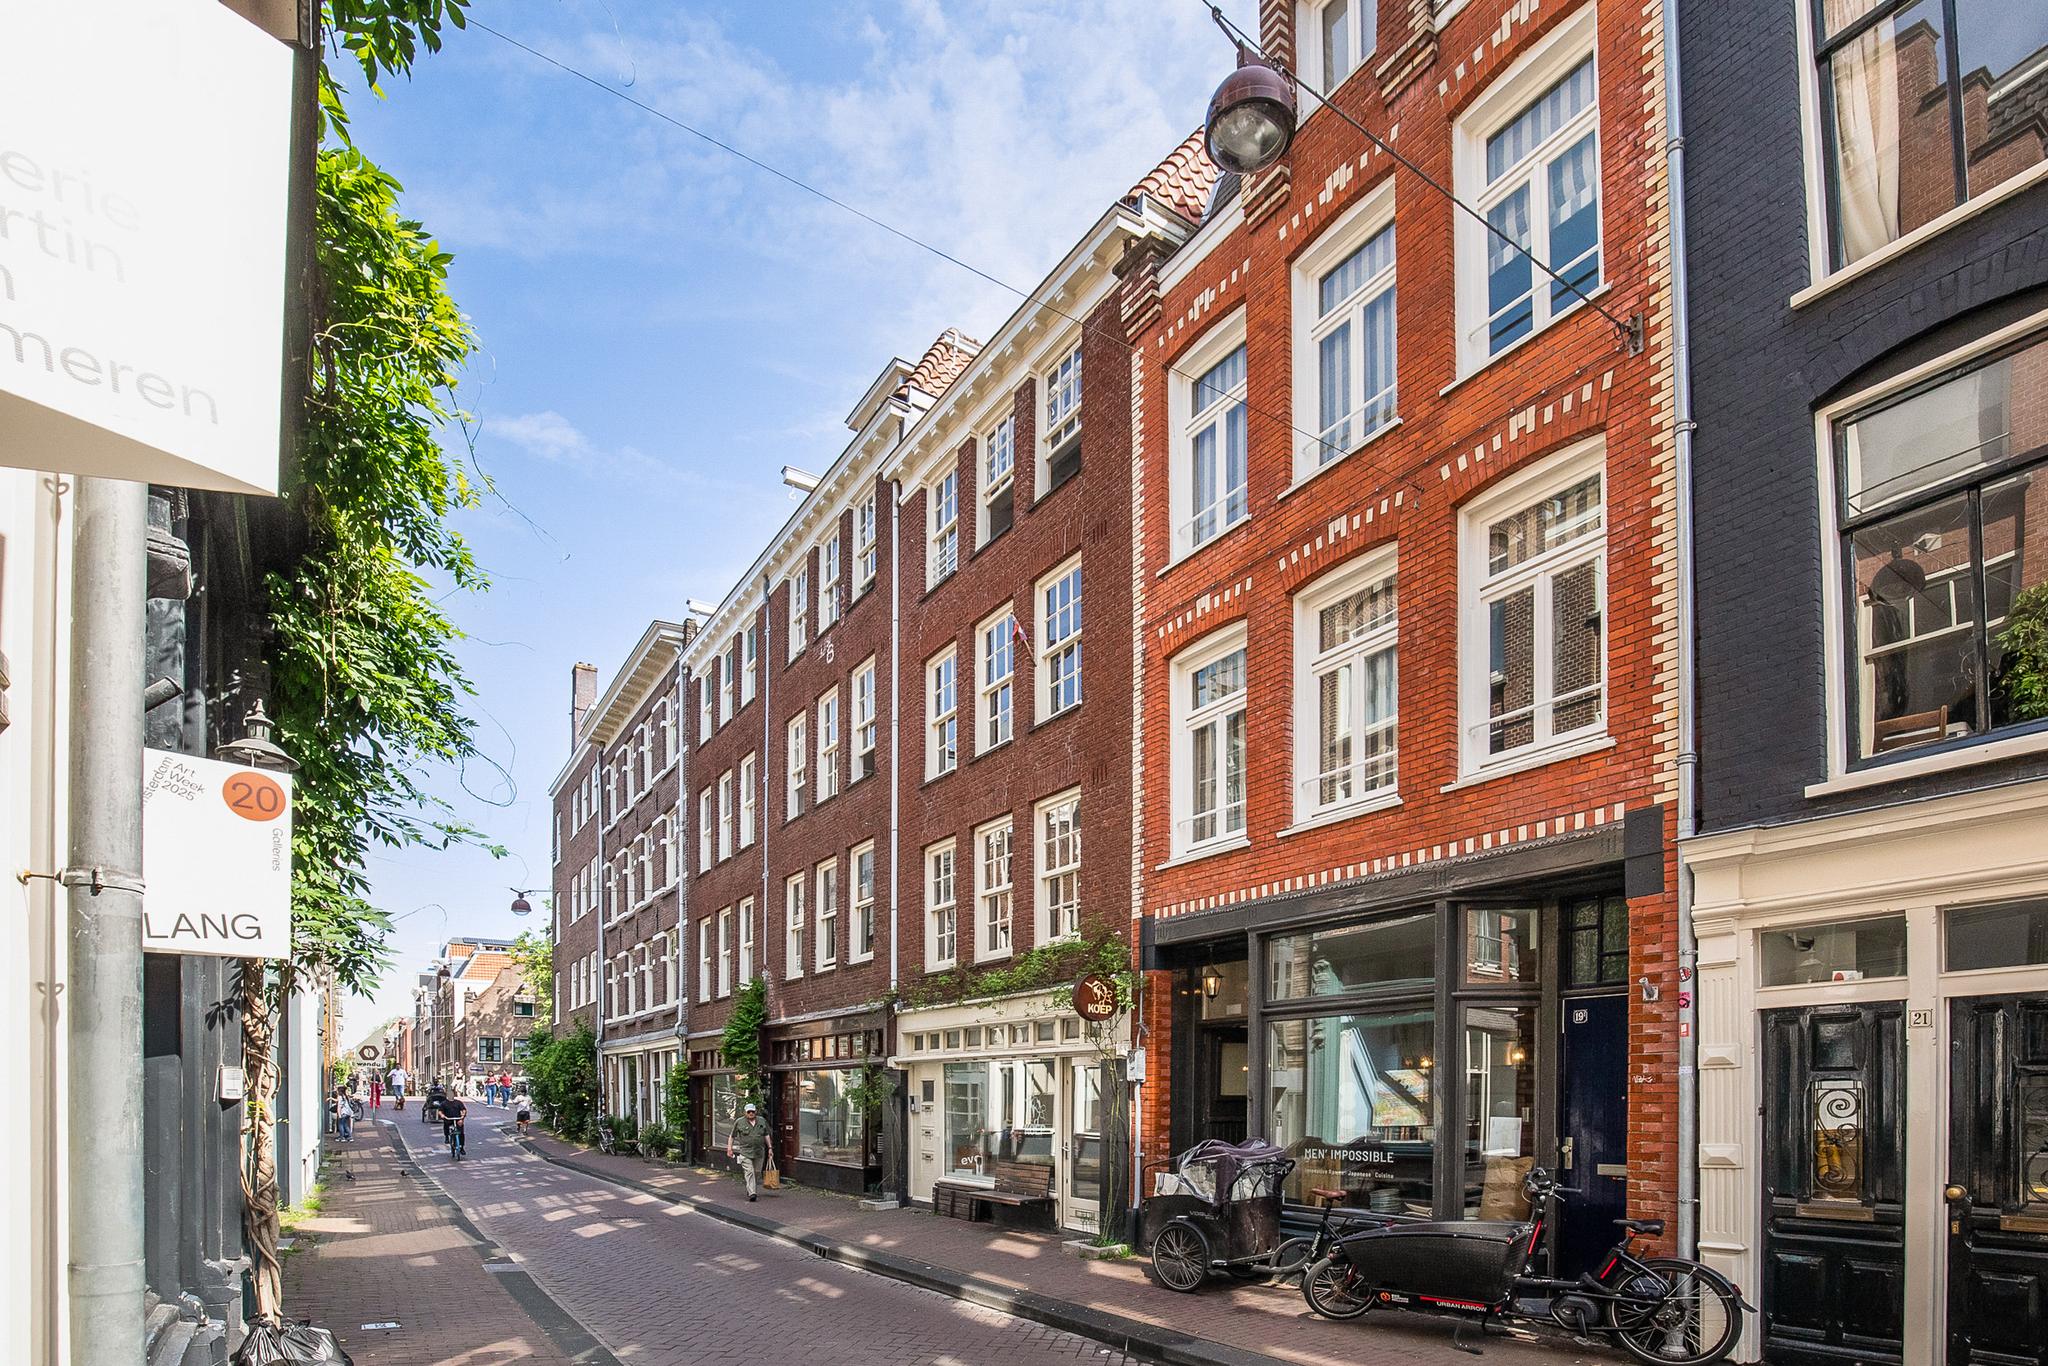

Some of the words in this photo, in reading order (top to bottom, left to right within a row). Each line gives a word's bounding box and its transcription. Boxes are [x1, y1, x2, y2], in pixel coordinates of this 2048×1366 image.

[0, 150, 141, 232] erie
[0, 205, 127, 284] rtin
[173, 763, 196, 778] Art
[161, 780, 196, 802] 2025
[169, 771, 206, 794] Week
[231, 782, 279, 813] 20
[272, 827, 284, 872] Galleries
[144, 912, 263, 940] LANG
[1088, 1003, 1113, 1014] KOEP
[1913, 1012, 1928, 1025] 21
[1330, 1149, 1394, 1163] IMPOSSIBLE
[1374, 1171, 1394, 1179] Cuisine
[1436, 1301, 1460, 1309] URBAN
[1461, 1303, 1487, 1313] ARROW
